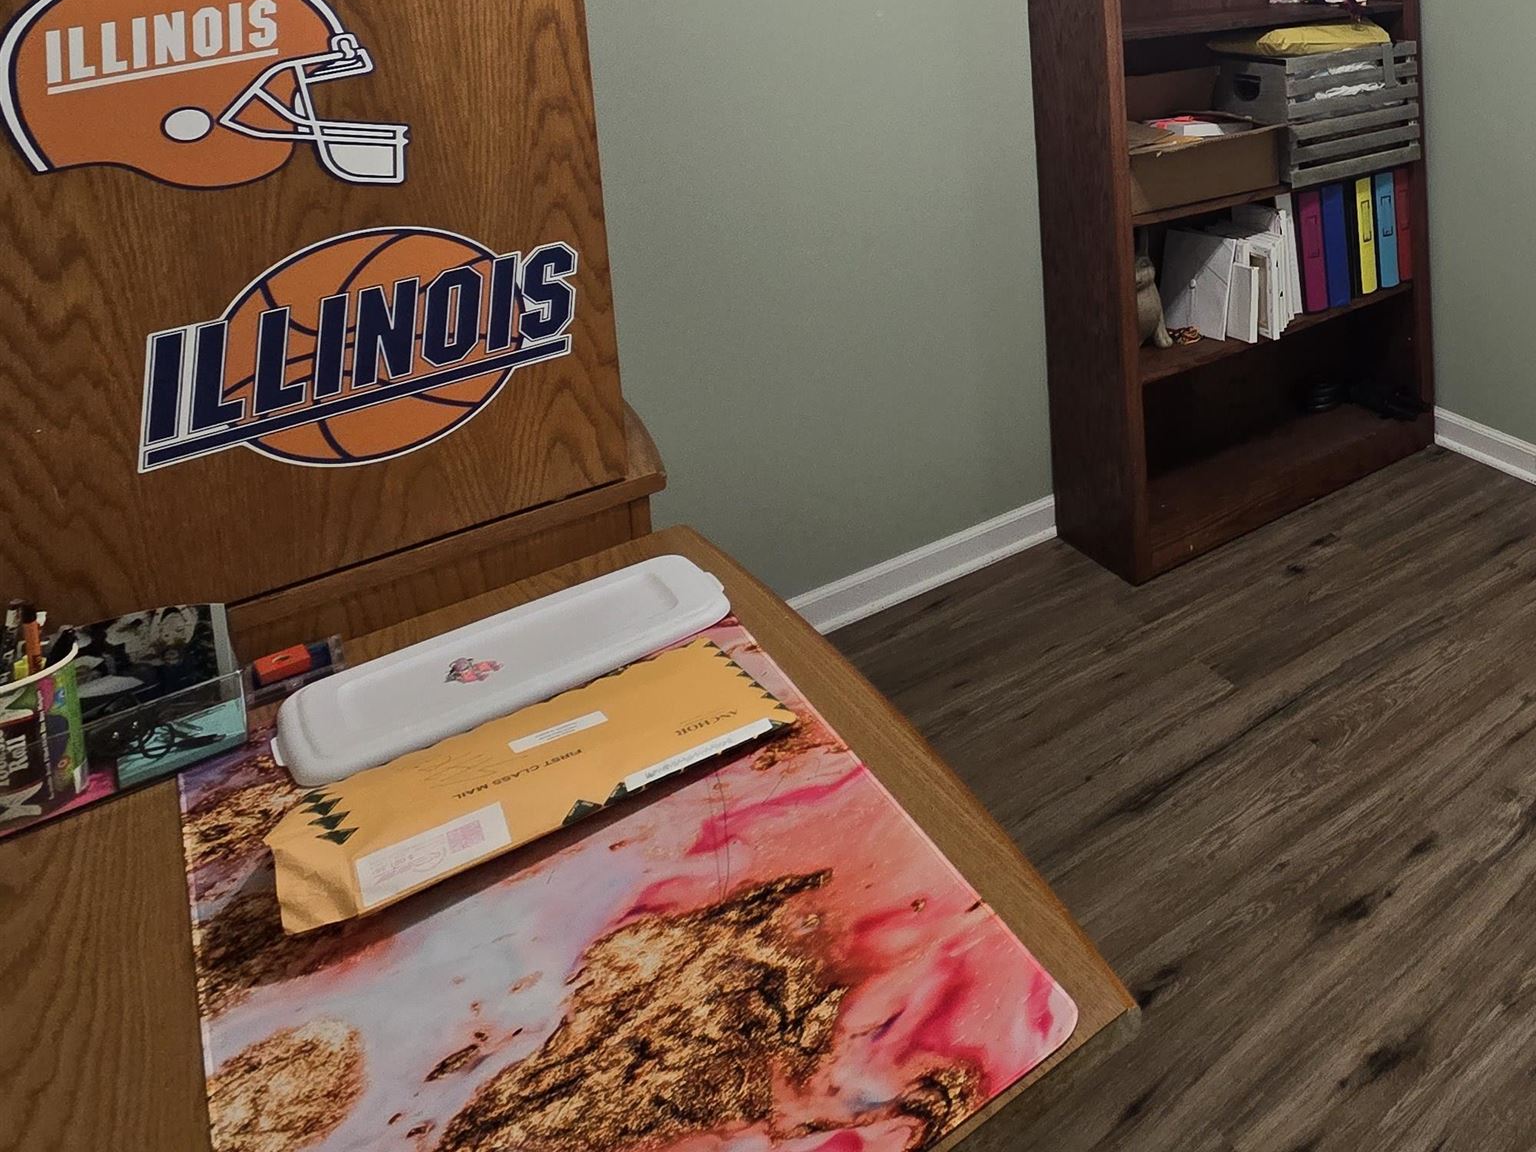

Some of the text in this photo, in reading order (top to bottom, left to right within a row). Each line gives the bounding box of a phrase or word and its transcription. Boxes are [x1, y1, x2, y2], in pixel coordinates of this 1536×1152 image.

[147, 243, 577, 444] ILLINOIS
[675, 708, 738, 737] ANCHOR
[9, 734, 29, 774] Roll
[542, 747, 583, 768] FIRST
[491, 762, 540, 786] CLASS
[452, 780, 490, 801] MAIL
